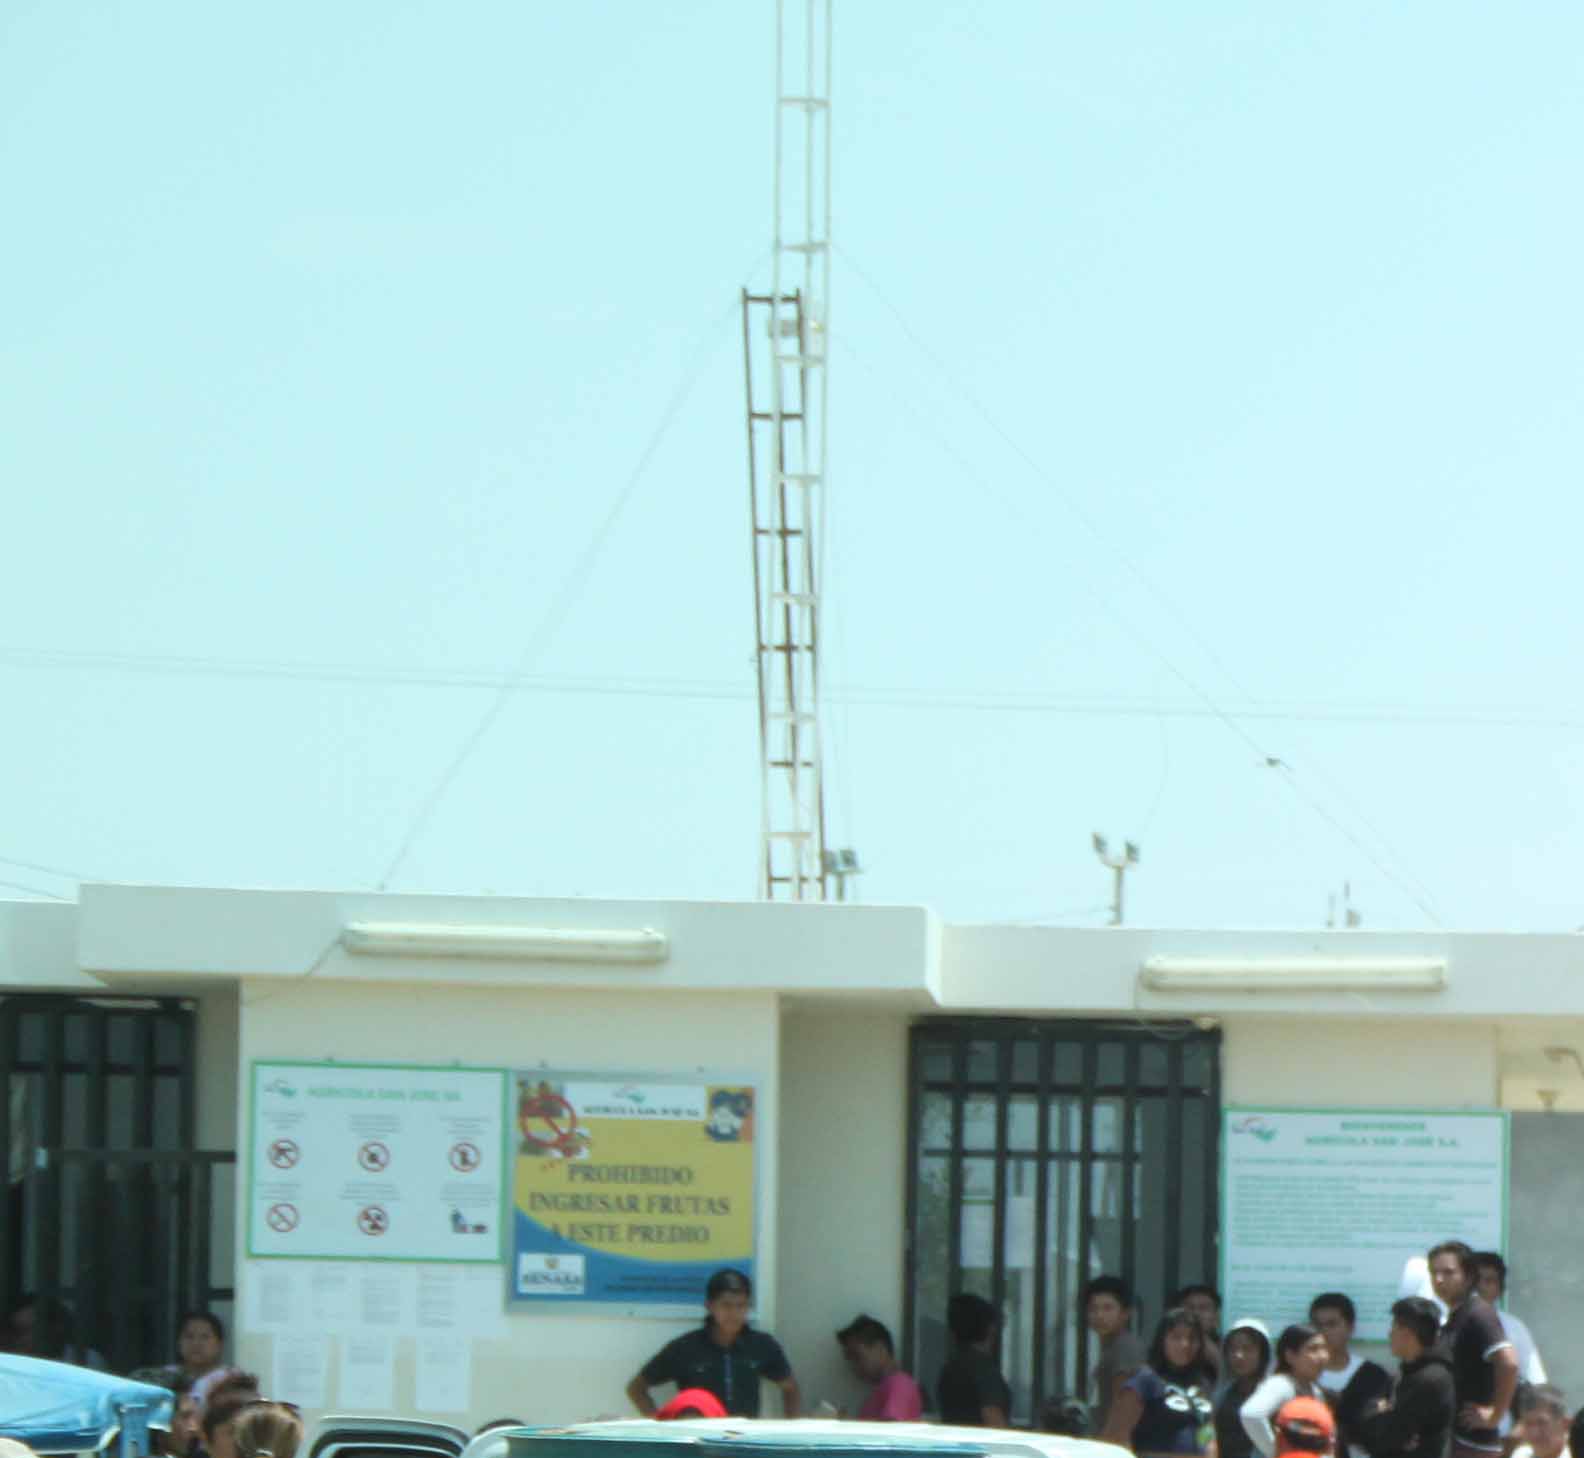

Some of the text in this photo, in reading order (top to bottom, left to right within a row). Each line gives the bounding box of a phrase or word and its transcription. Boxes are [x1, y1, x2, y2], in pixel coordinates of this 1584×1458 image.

[567, 1163, 695, 1186] PROHIBIDO
[528, 1191, 731, 1217] INGRESAR FRUTAS
[567, 1222, 623, 1243] ESTE
[626, 1223, 711, 1244] PREDIO
